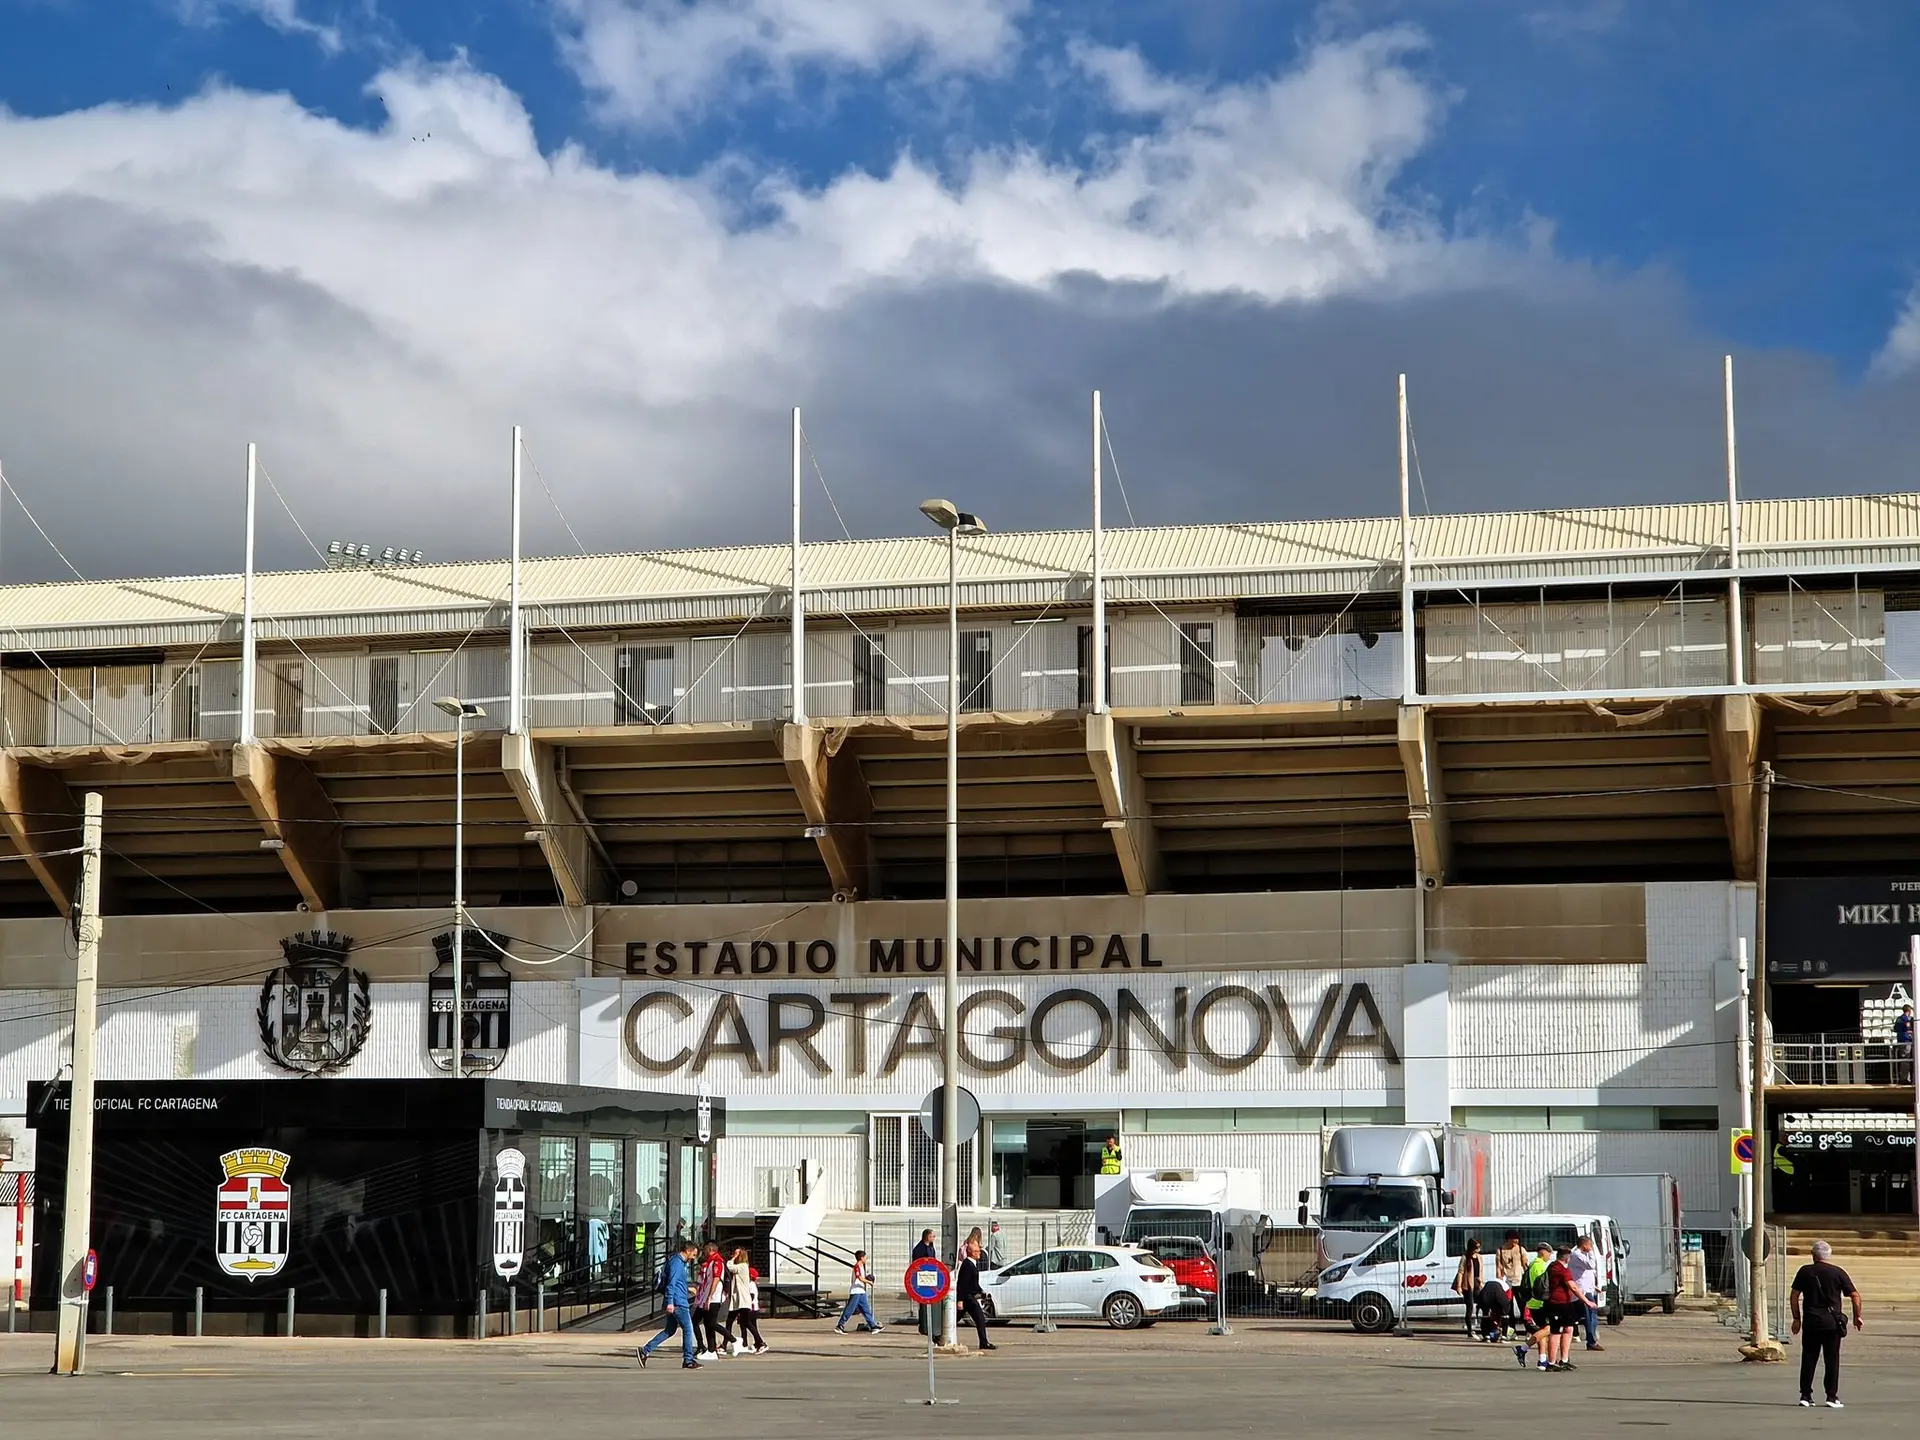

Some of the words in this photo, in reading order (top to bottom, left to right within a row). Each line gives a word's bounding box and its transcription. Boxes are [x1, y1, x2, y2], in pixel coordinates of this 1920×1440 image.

[1838, 904, 1901, 924] MIKI
[625, 939, 837, 975] ESTADIO
[869, 933, 1164, 973] MUNICIPAL
[446, 1000, 506, 1010] CRTAGENA
[624, 982, 1402, 1075] CARTAGONOVA
[94, 1098, 134, 1110] OFICIAL
[138, 1098, 152, 1110] FC
[154, 1098, 218, 1110] CARTAGENA
[496, 1097, 513, 1110] TIENDA
[221, 1211, 231, 1219] FC
[233, 1211, 286, 1219] CARTAGENA
